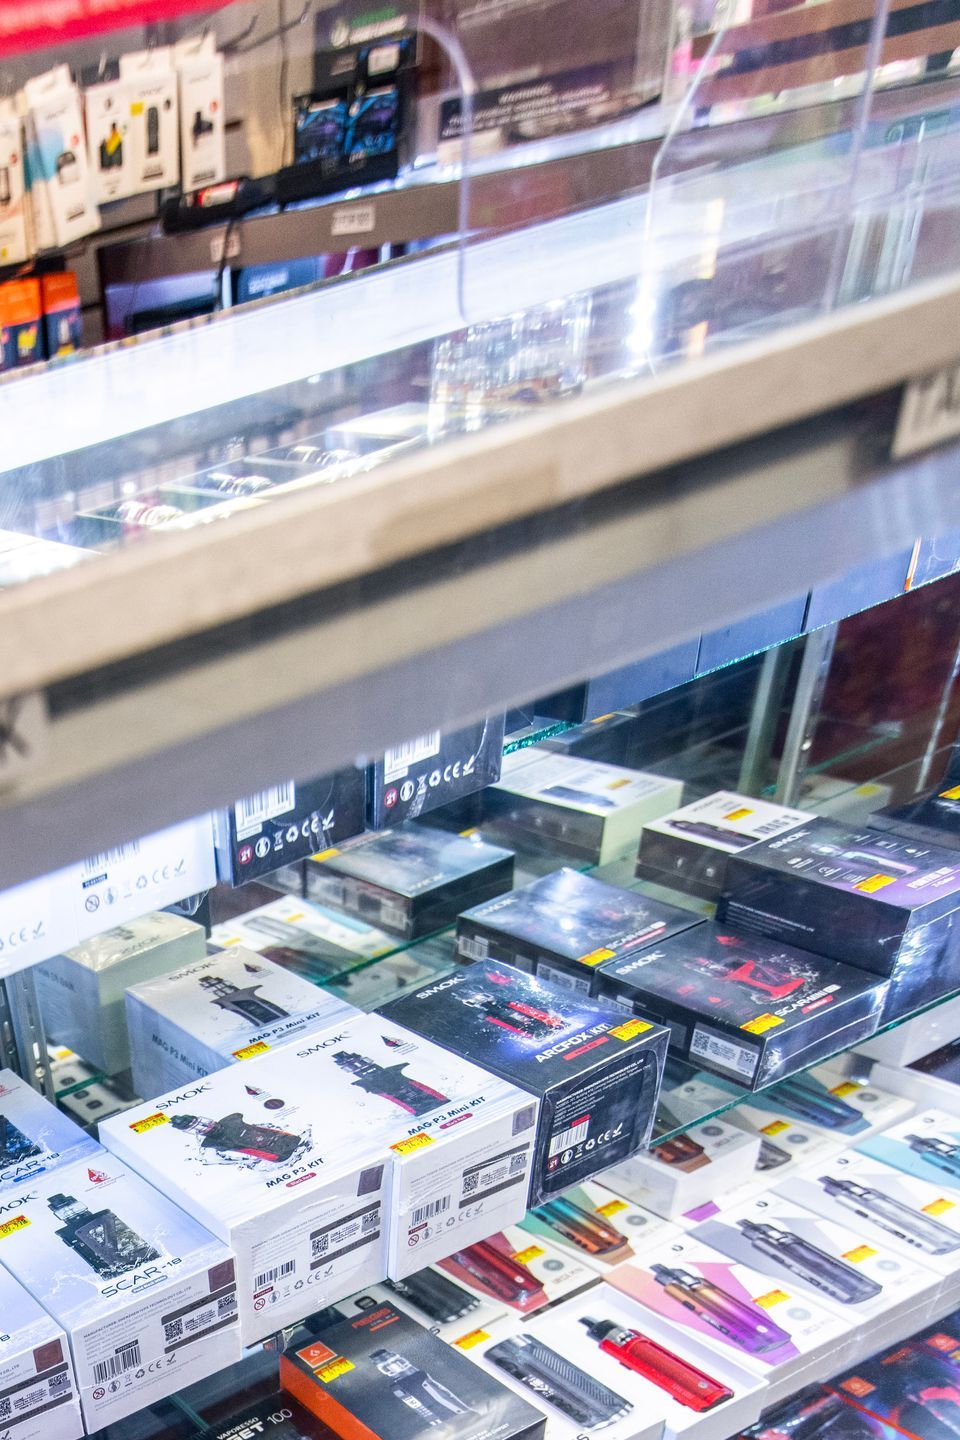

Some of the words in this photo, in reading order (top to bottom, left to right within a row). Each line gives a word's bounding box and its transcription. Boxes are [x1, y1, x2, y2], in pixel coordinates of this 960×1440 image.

[168, 961, 213, 982] SMOK
[615, 951, 666, 975] SMOK
[415, 974, 466, 1000] SMOK
[248, 1032, 271, 1045] MAG
[272, 1025, 285, 1035] P3
[285, 1018, 305, 1032] Mini
[305, 1011, 321, 1022] KIT
[296, 1032, 349, 1059] SMOK
[534, 1034, 589, 1064] ARCFOX
[155, 1084, 213, 1111] SMOK
[407, 1122, 432, 1137] MAG
[433, 1113, 448, 1125] P3
[448, 1104, 469, 1119] Mini
[469, 1096, 487, 1108] KIT
[265, 1172, 291, 1189] MAG
[292, 1166, 307, 1178] P3
[307, 1157, 326, 1170] KIT
[100, 1256, 183, 1299] SCAR-18
[216, 1416, 259, 1440] VAPORESSO
[266, 1408, 293, 1426] 100
